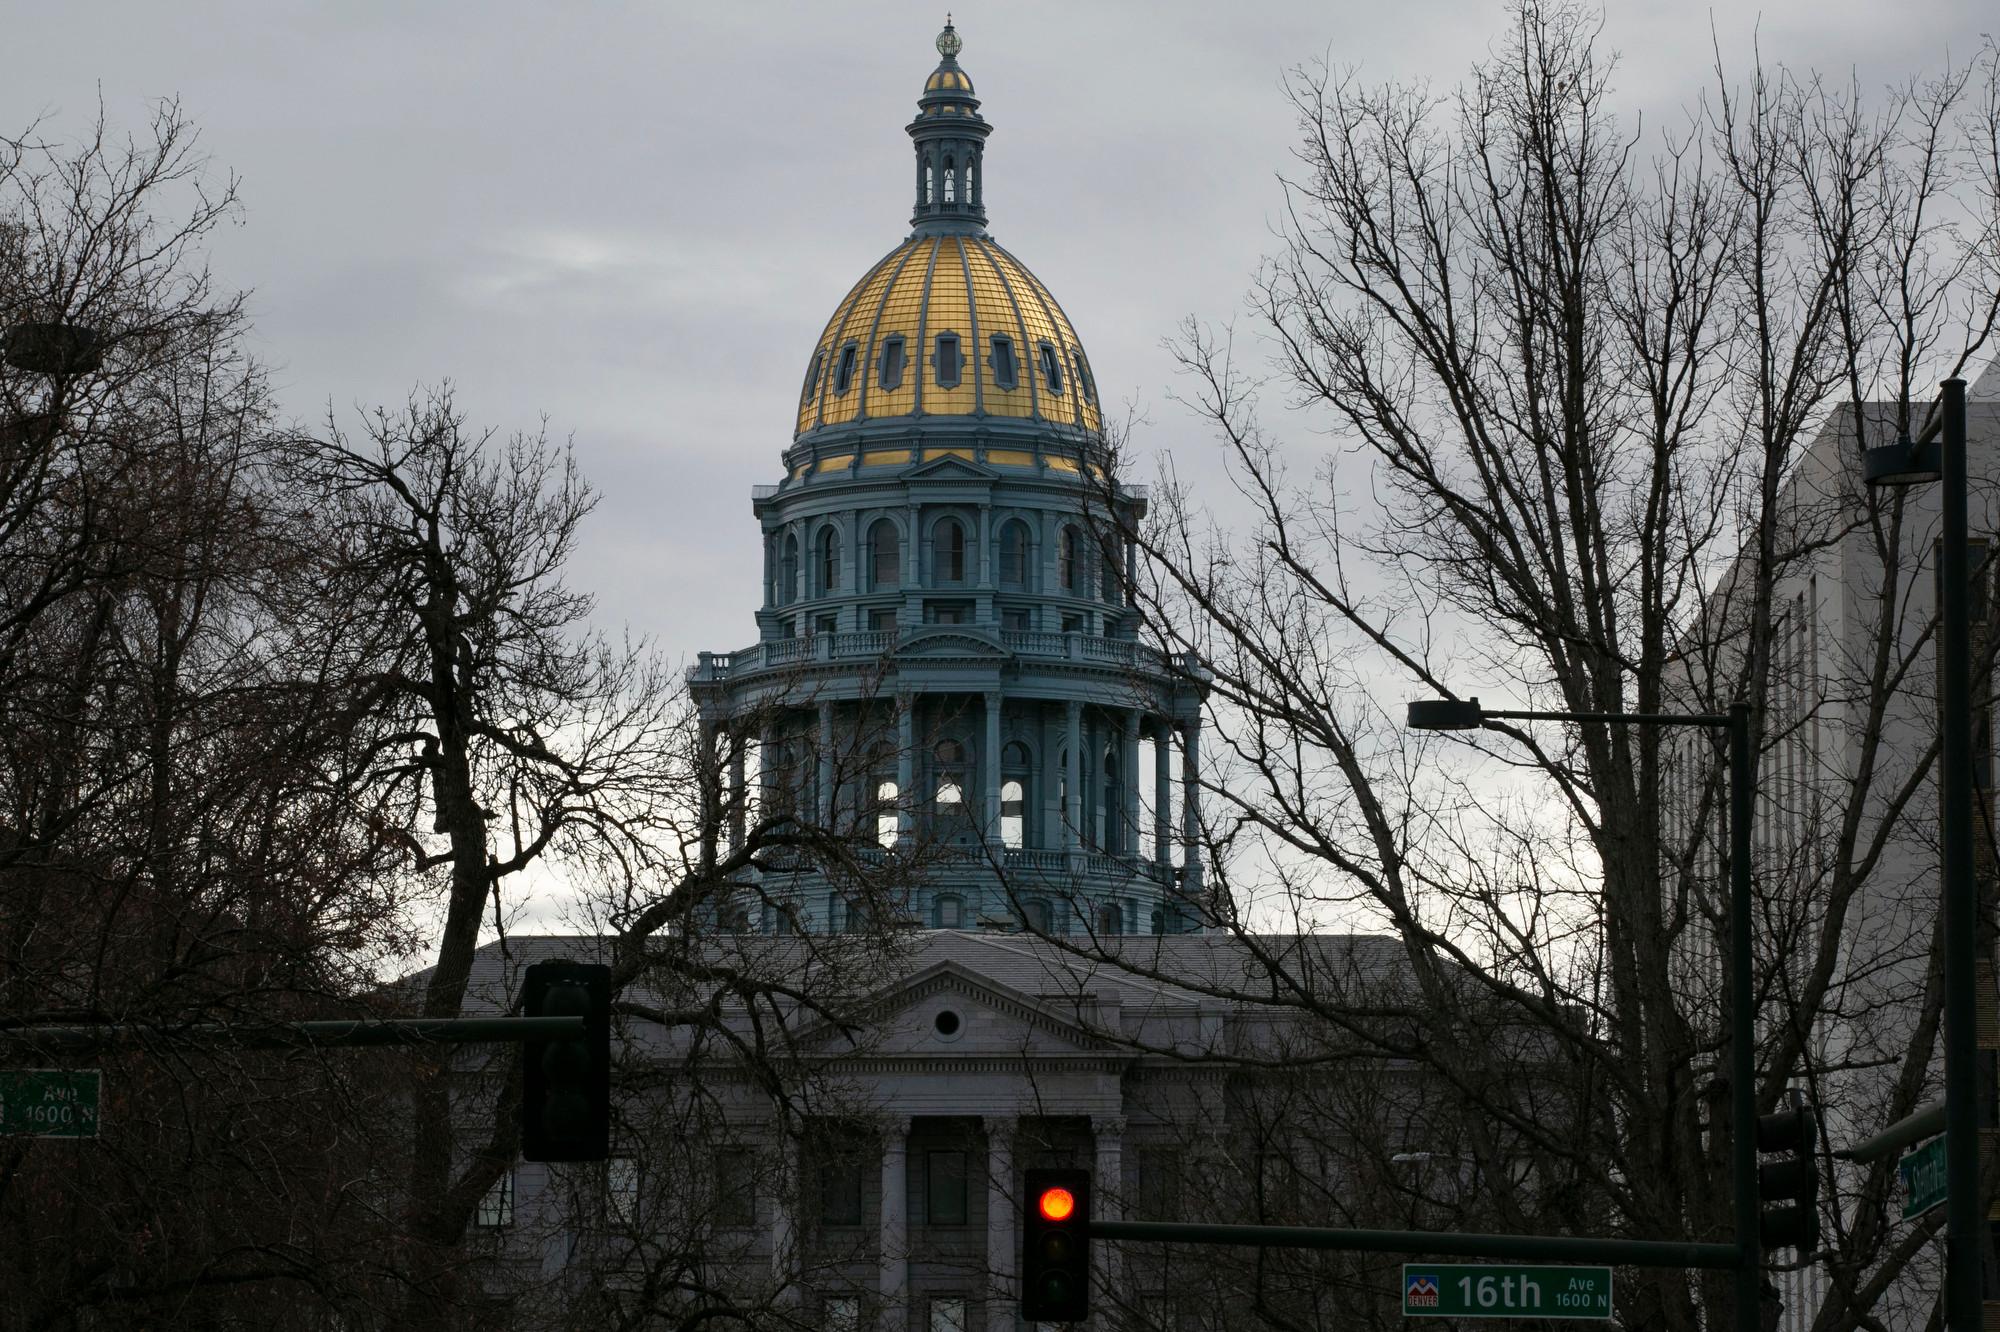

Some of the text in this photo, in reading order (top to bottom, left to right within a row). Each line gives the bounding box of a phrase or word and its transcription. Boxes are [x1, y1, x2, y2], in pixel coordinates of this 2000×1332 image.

[43, 1086, 78, 1101] Ave
[26, 1105, 72, 1123] 1600
[1457, 1274, 1541, 1307] 16th
[1568, 1277, 1594, 1291] Ave
[1408, 1296, 1439, 1307] DENVER
[1556, 1293, 1607, 1307] 1600 N
